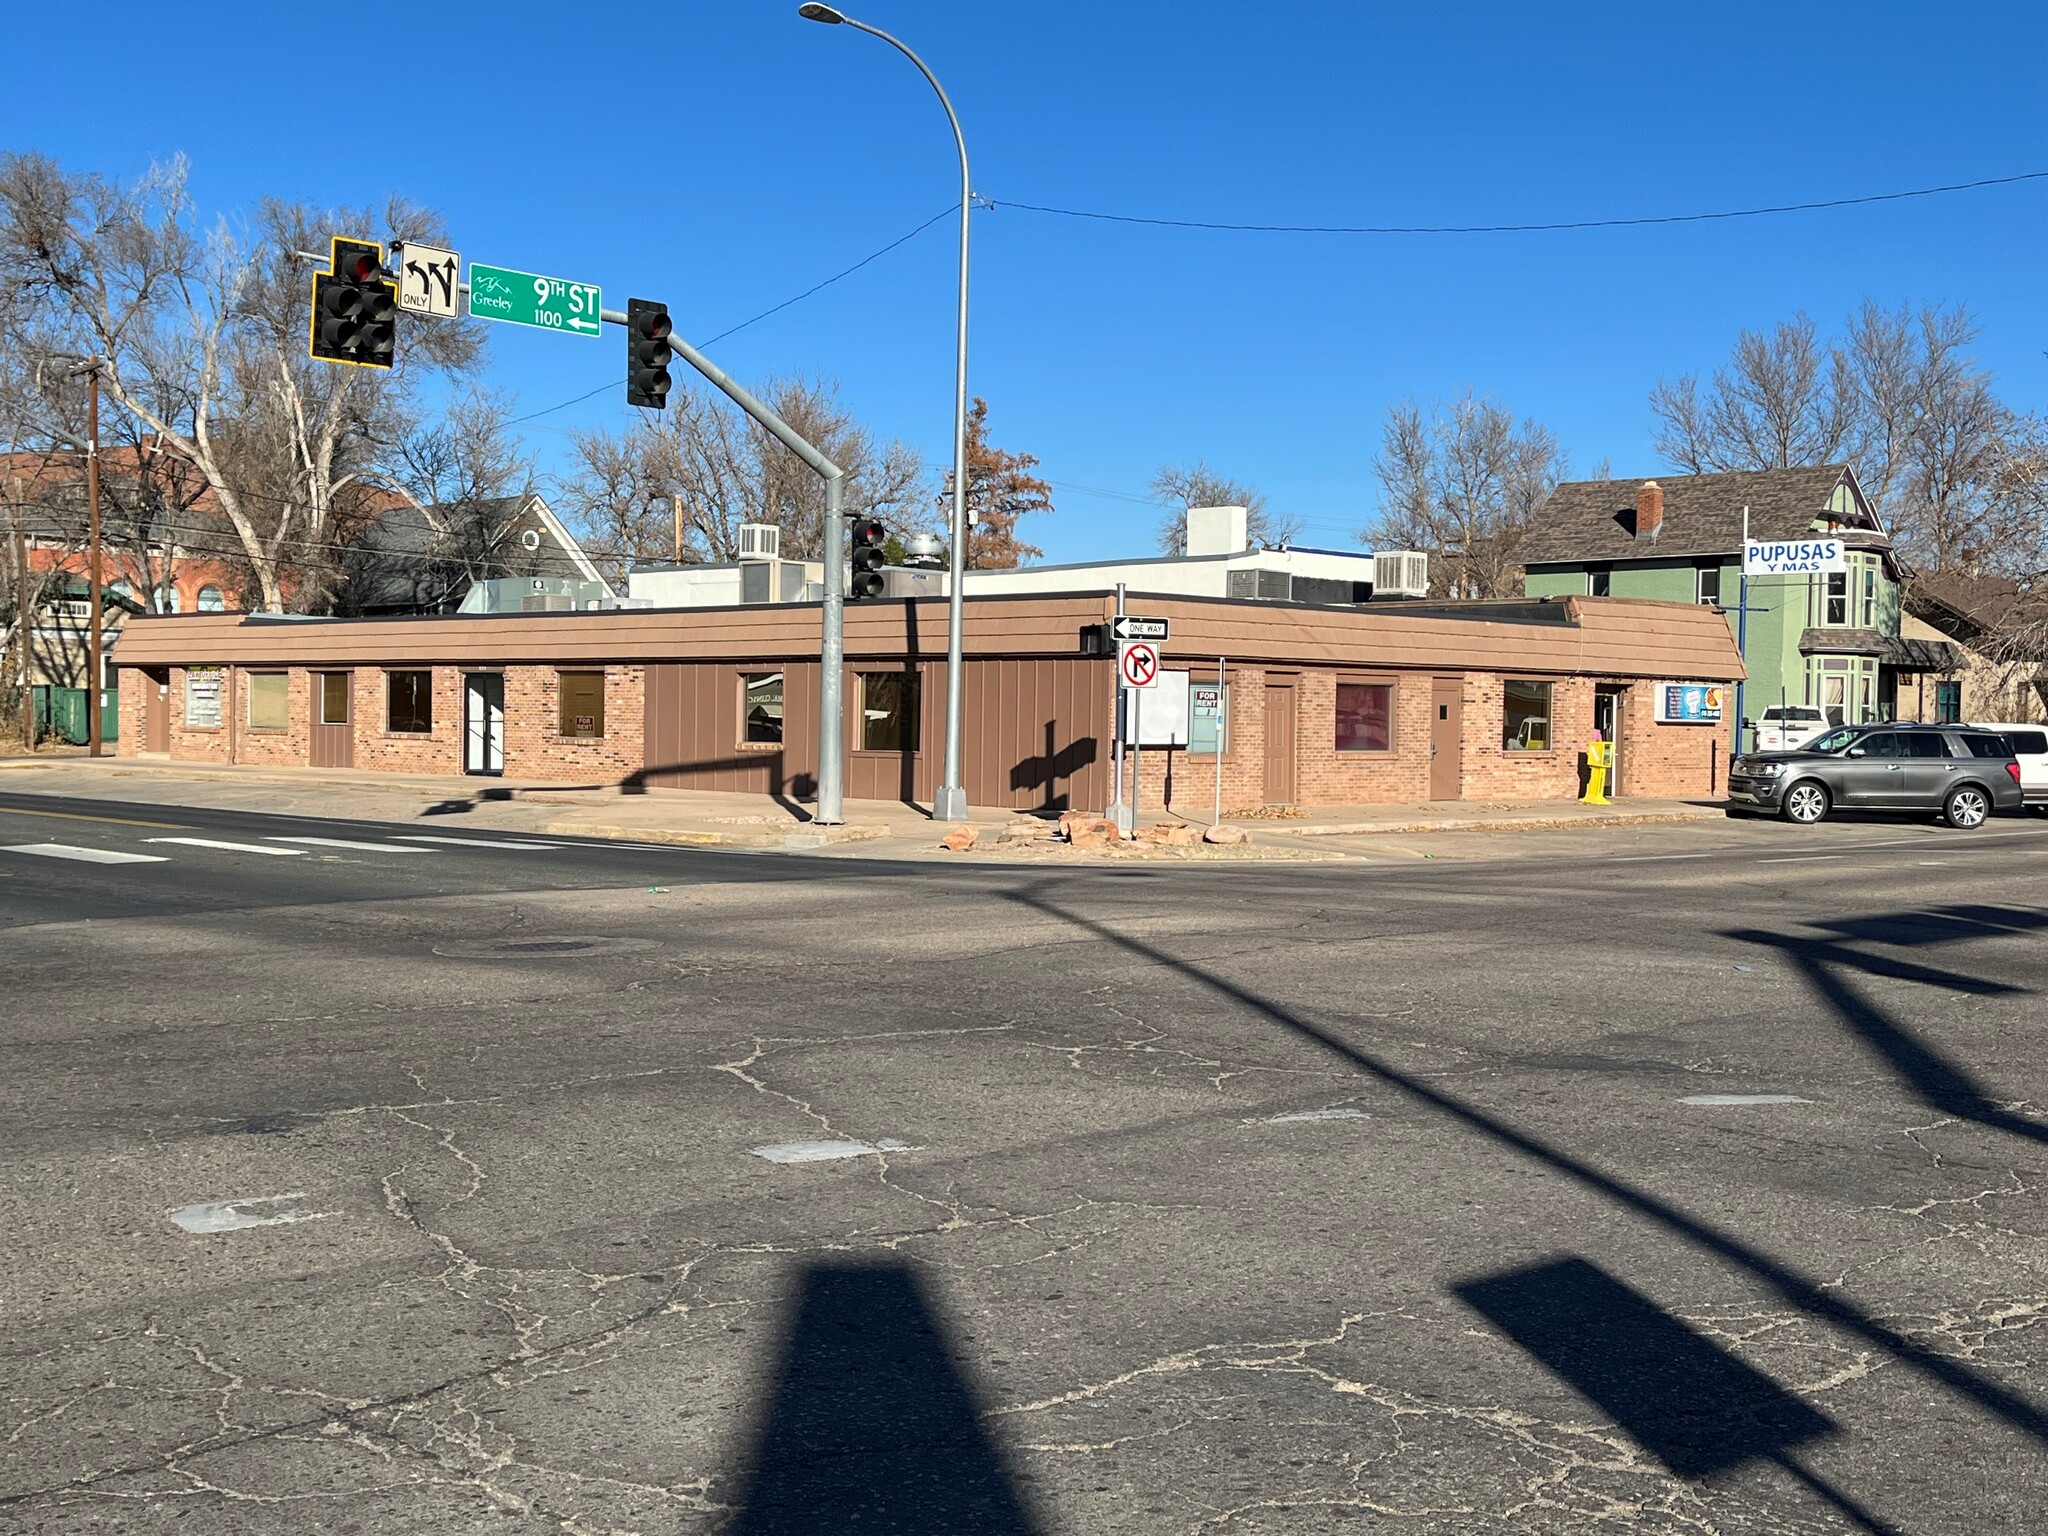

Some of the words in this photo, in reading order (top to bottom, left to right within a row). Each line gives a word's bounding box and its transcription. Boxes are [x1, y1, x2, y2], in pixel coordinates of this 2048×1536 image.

[403, 293, 427, 307] ONLY
[472, 292, 513, 312] Greeley
[533, 278, 565, 306] 9TH
[568, 284, 597, 315] ST
[534, 309, 562, 327] 1100
[1749, 543, 1836, 562] PUPUSAS
[1767, 563, 1777, 572] Y
[1782, 562, 1820, 571] MAS
[1130, 623, 1144, 633] ONE
[1147, 624, 1162, 633] WAY
[1196, 699, 1217, 707] RENT
[1199, 692, 1215, 700] FOR
